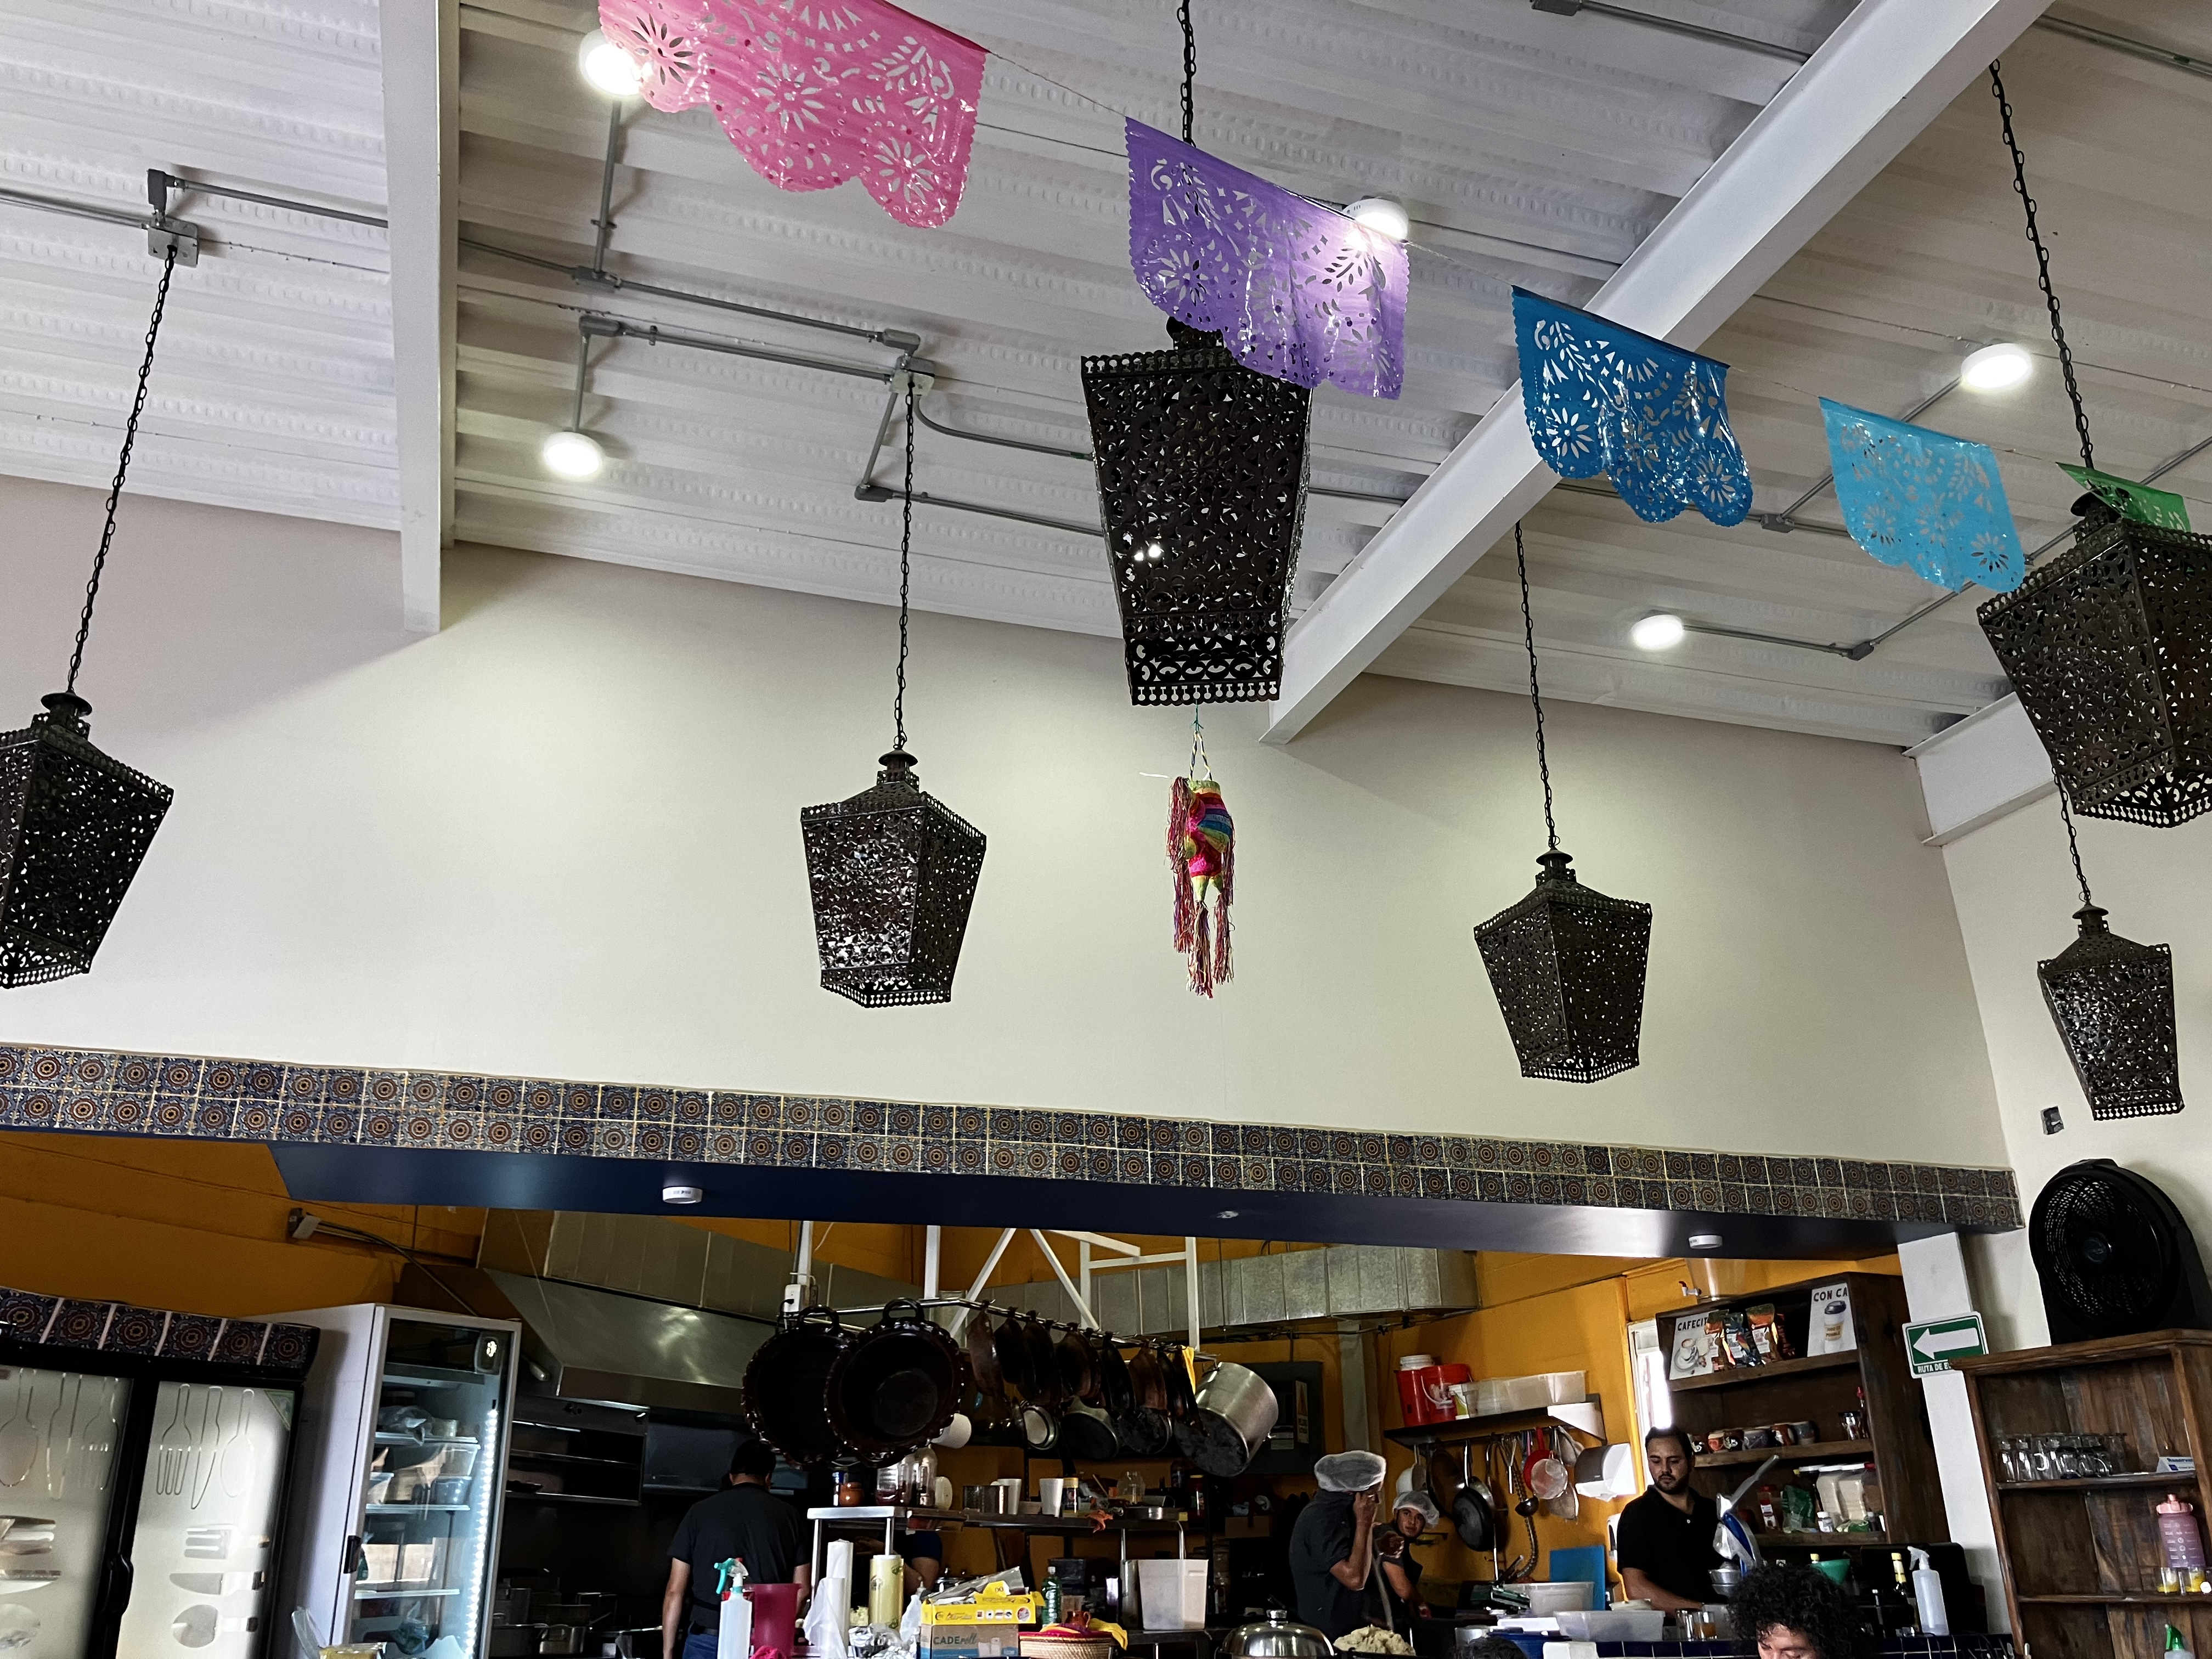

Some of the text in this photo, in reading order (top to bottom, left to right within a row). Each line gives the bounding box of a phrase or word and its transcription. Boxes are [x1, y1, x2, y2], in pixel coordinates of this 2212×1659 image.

[1813, 1290, 1832, 1302] CON
[1917, 1364, 1934, 1373] RUTA
[1934, 1363, 1943, 1371] DE
